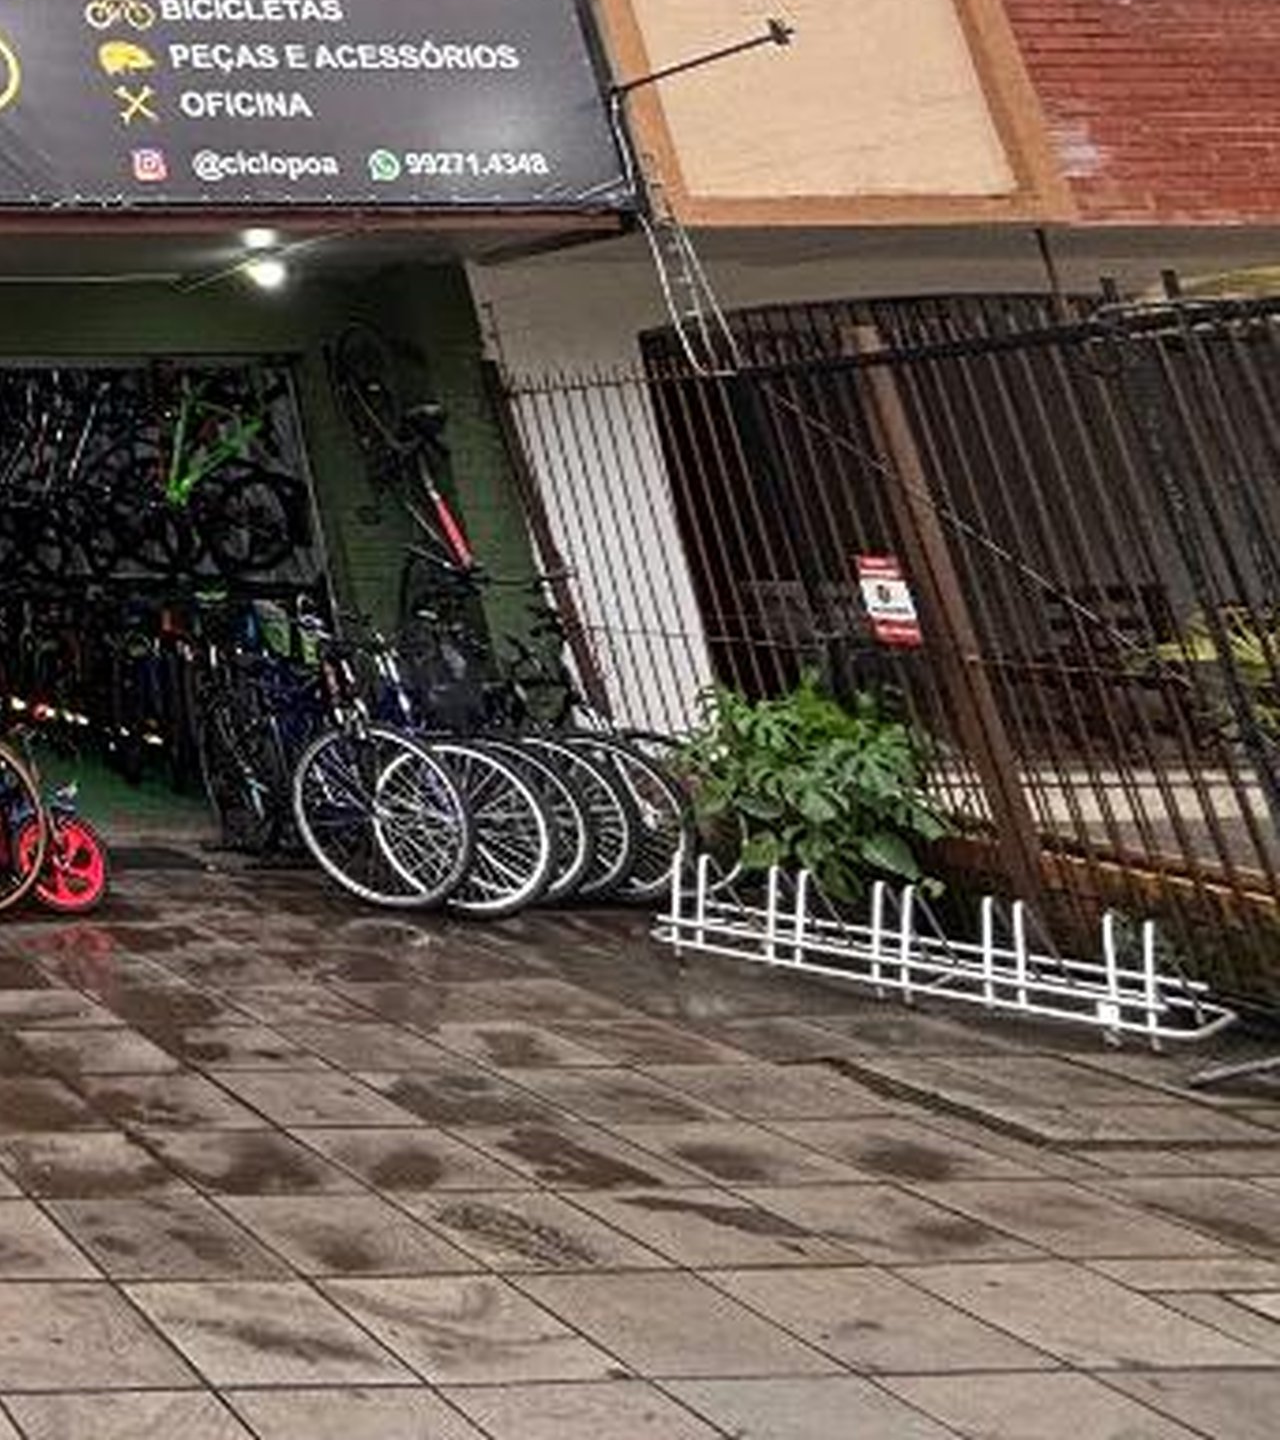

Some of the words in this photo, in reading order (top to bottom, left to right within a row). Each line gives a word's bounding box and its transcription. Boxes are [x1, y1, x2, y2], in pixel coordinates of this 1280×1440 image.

[169, 44, 279, 73] PEÇAS
[285, 45, 308, 69] E
[314, 41, 520, 70] ACESSÓRIOS
[180, 92, 313, 119] OFICINA
[192, 151, 339, 182] @ciclopoa
